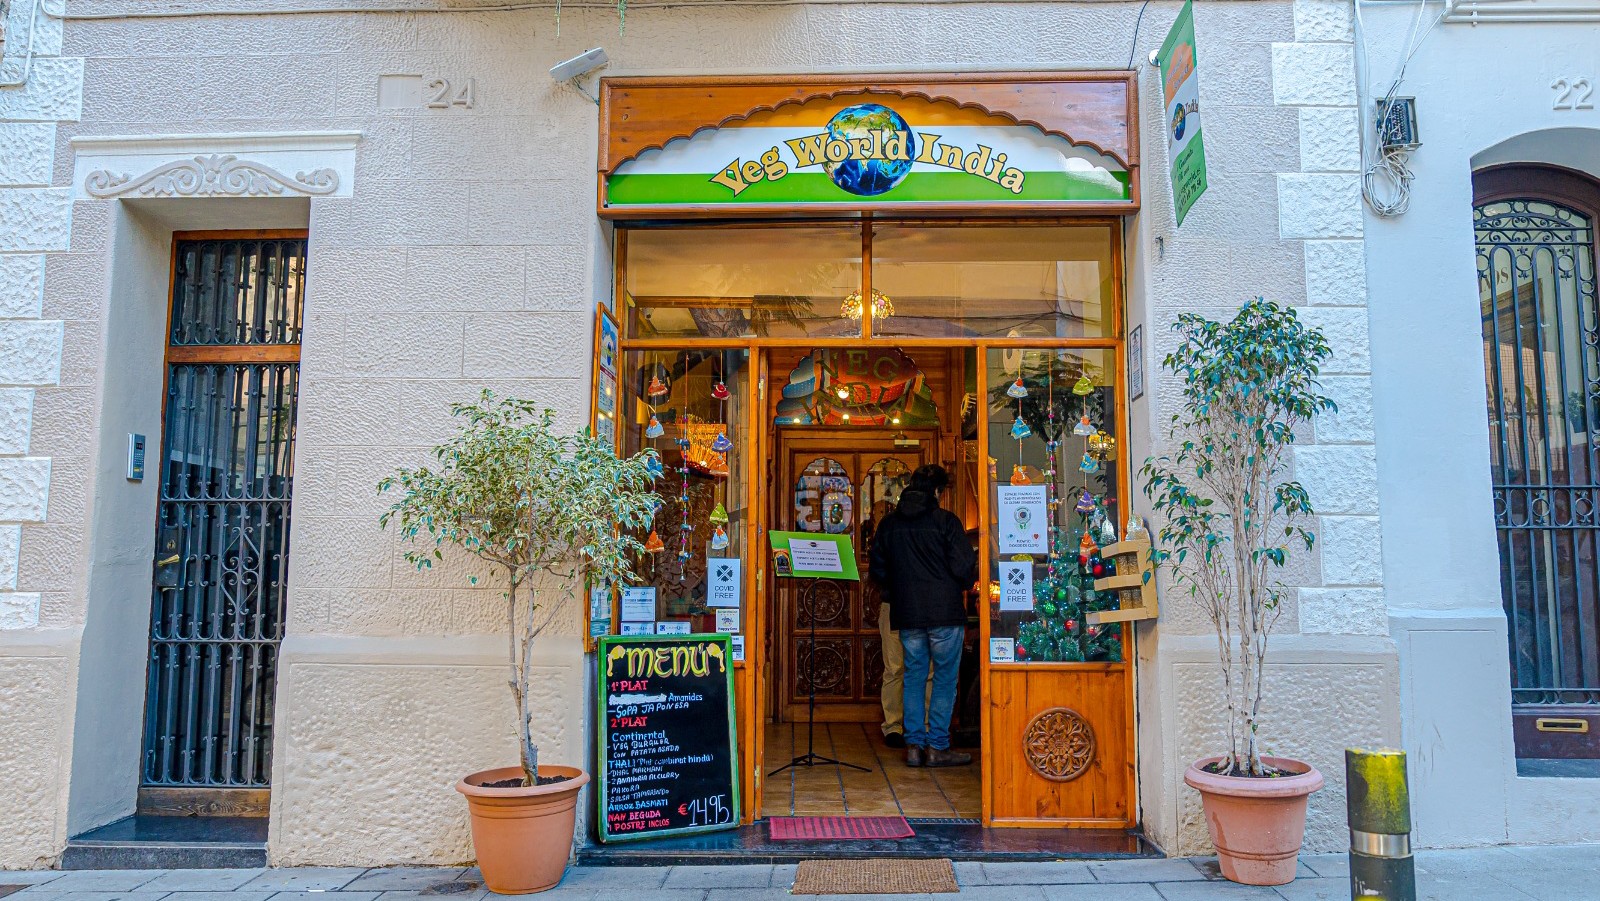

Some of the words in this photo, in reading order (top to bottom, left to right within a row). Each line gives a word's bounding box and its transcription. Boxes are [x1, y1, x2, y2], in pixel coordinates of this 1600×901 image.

[427, 78, 475, 110] 24
[1551, 77, 1594, 110] 22
[708, 145, 788, 197] Veg
[784, 129, 909, 169] World
[917, 132, 1026, 195] India
[620, 680, 649, 691] PLAT
[621, 716, 648, 728] PLAT
[612, 729, 666, 742] Continental
[630, 746, 656, 757] PATATA
[635, 799, 669, 810] BASMATI
[629, 810, 661, 820] BEGUDA
[614, 821, 646, 831] POSTRE
